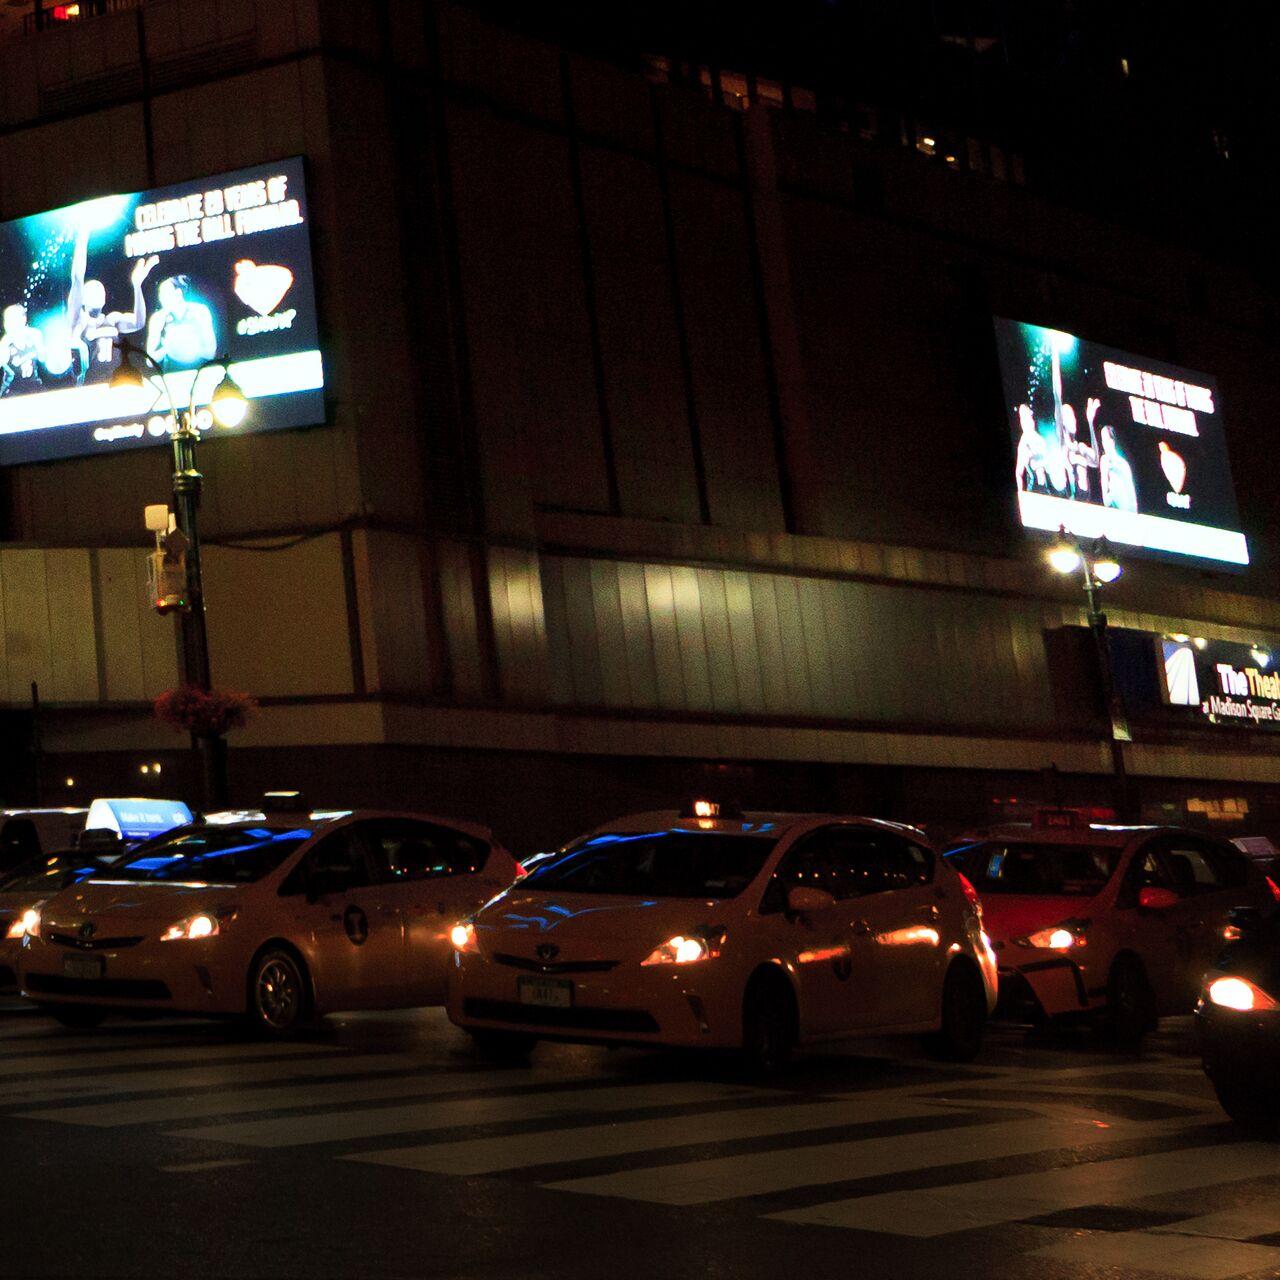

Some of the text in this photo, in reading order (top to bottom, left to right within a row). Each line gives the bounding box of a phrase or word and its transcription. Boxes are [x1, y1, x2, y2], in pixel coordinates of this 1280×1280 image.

[1216, 663, 1248, 696] The
[1210, 695, 1247, 718] Madison
[1247, 699, 1273, 724] Square
